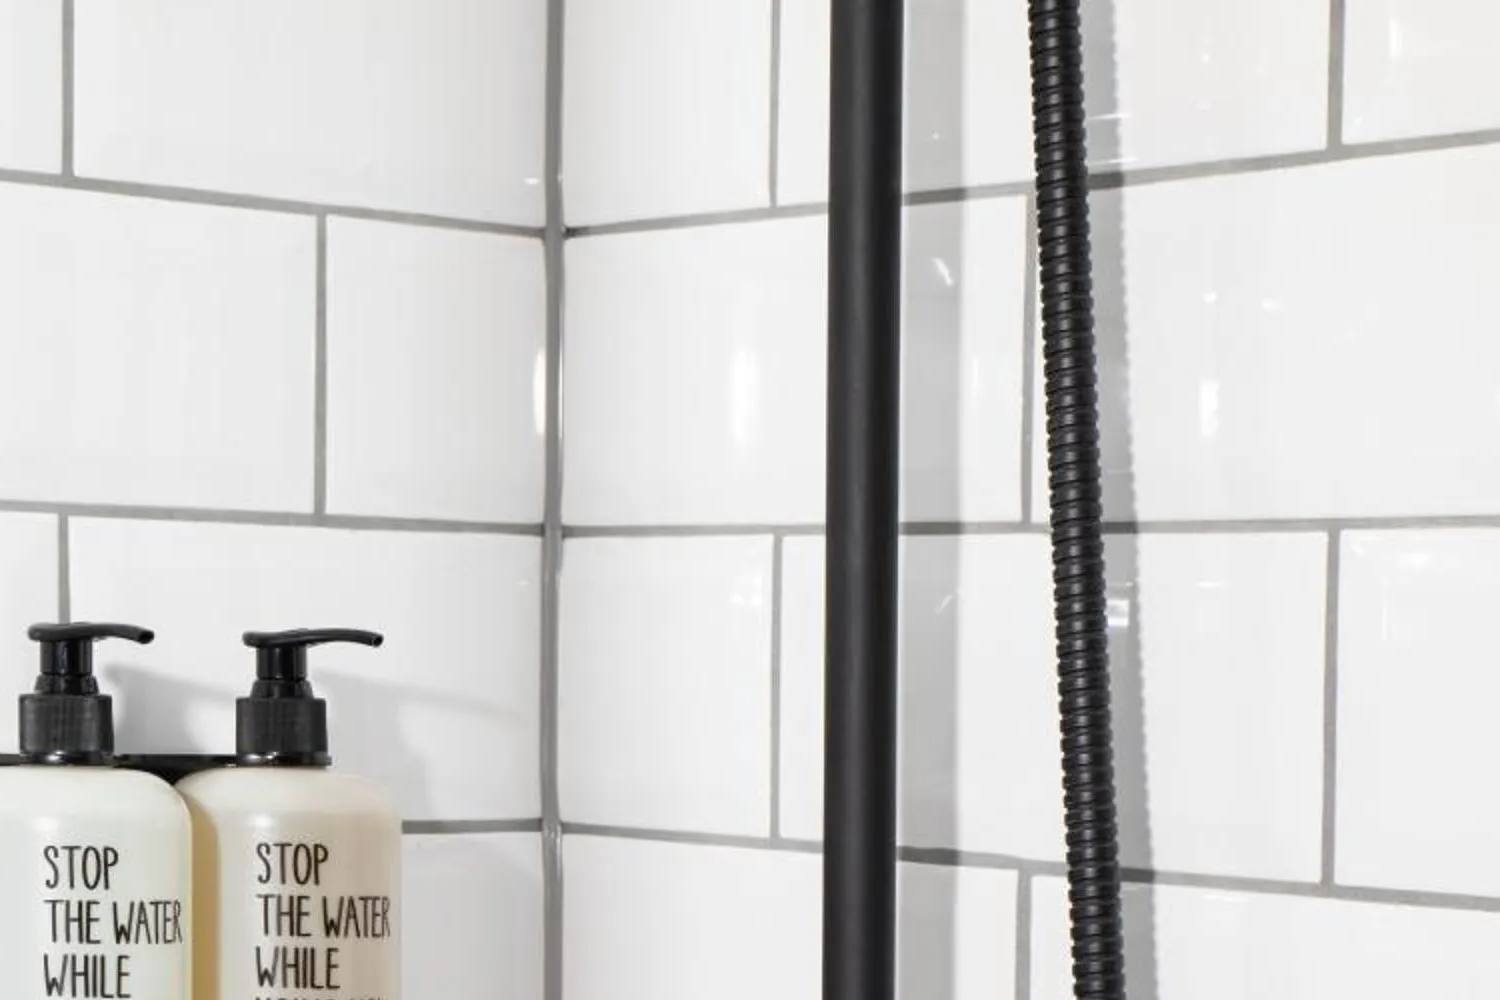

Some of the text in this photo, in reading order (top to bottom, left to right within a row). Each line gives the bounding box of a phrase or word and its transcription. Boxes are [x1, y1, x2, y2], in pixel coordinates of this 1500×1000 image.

[43, 845, 120, 891] STOP
[256, 842, 330, 885] STOP
[43, 899, 184, 945] THE WATER
[256, 894, 391, 940] THE WATER
[43, 953, 132, 1000] WHILE
[256, 946, 341, 990] WHILE
